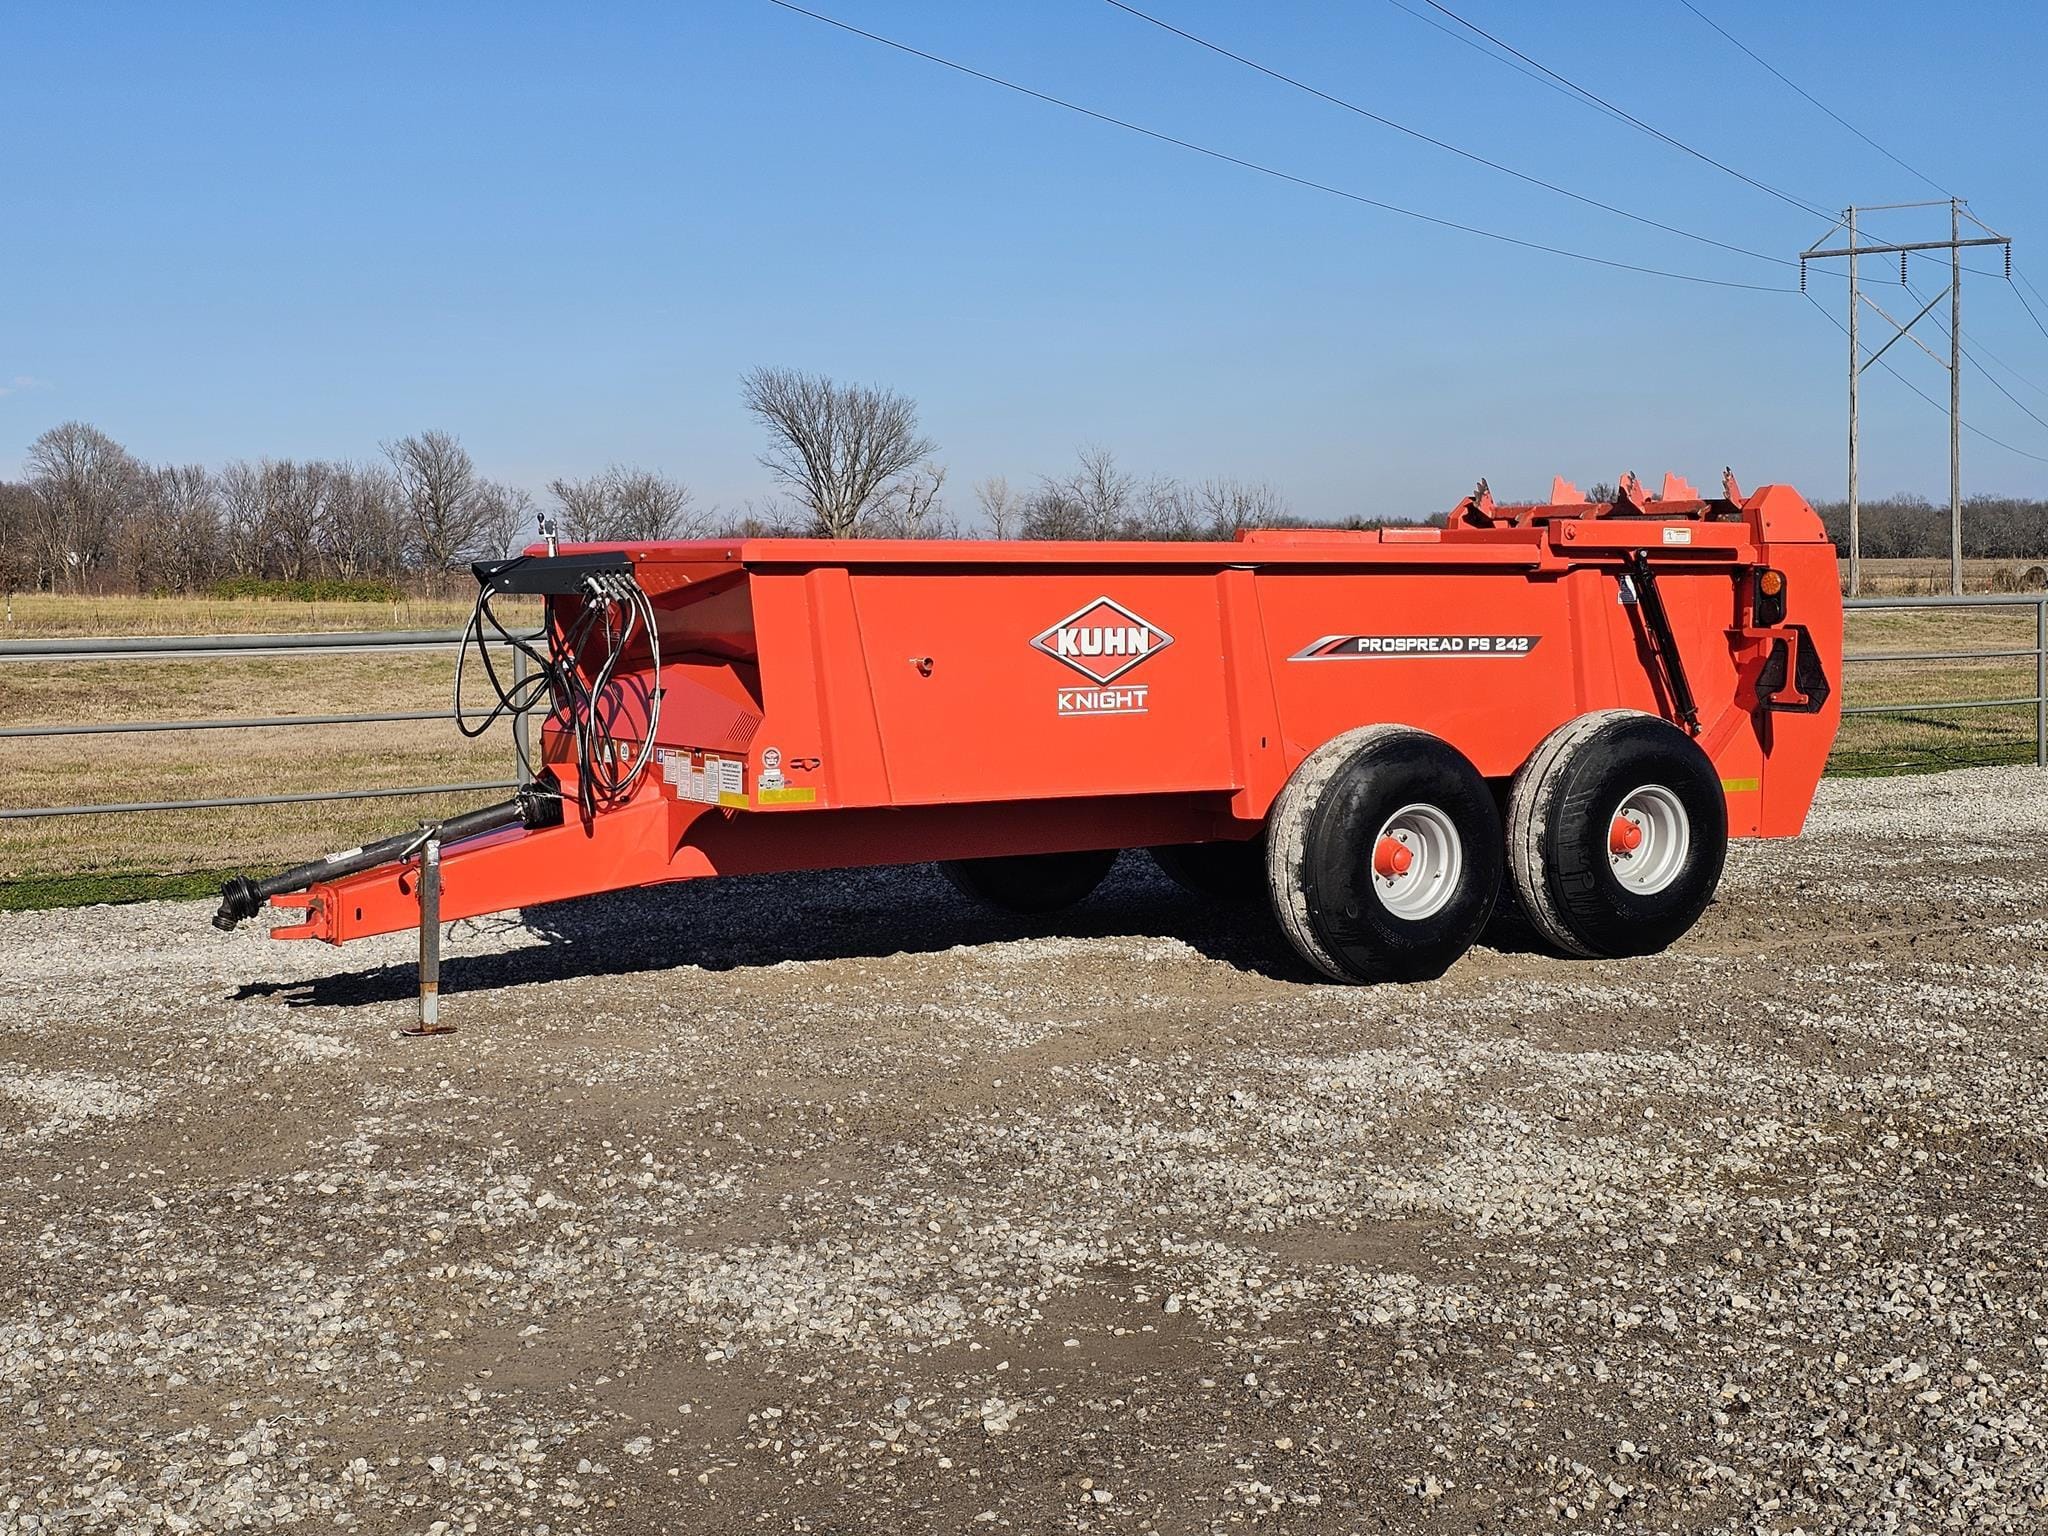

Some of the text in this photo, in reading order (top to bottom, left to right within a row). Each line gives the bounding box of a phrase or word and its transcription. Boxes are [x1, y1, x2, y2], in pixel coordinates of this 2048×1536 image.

[1057, 627, 1149, 656] KUHN
[1358, 637, 1529, 652] PROSPREAD PS 242
[1058, 690, 1148, 710] KNIGHT
